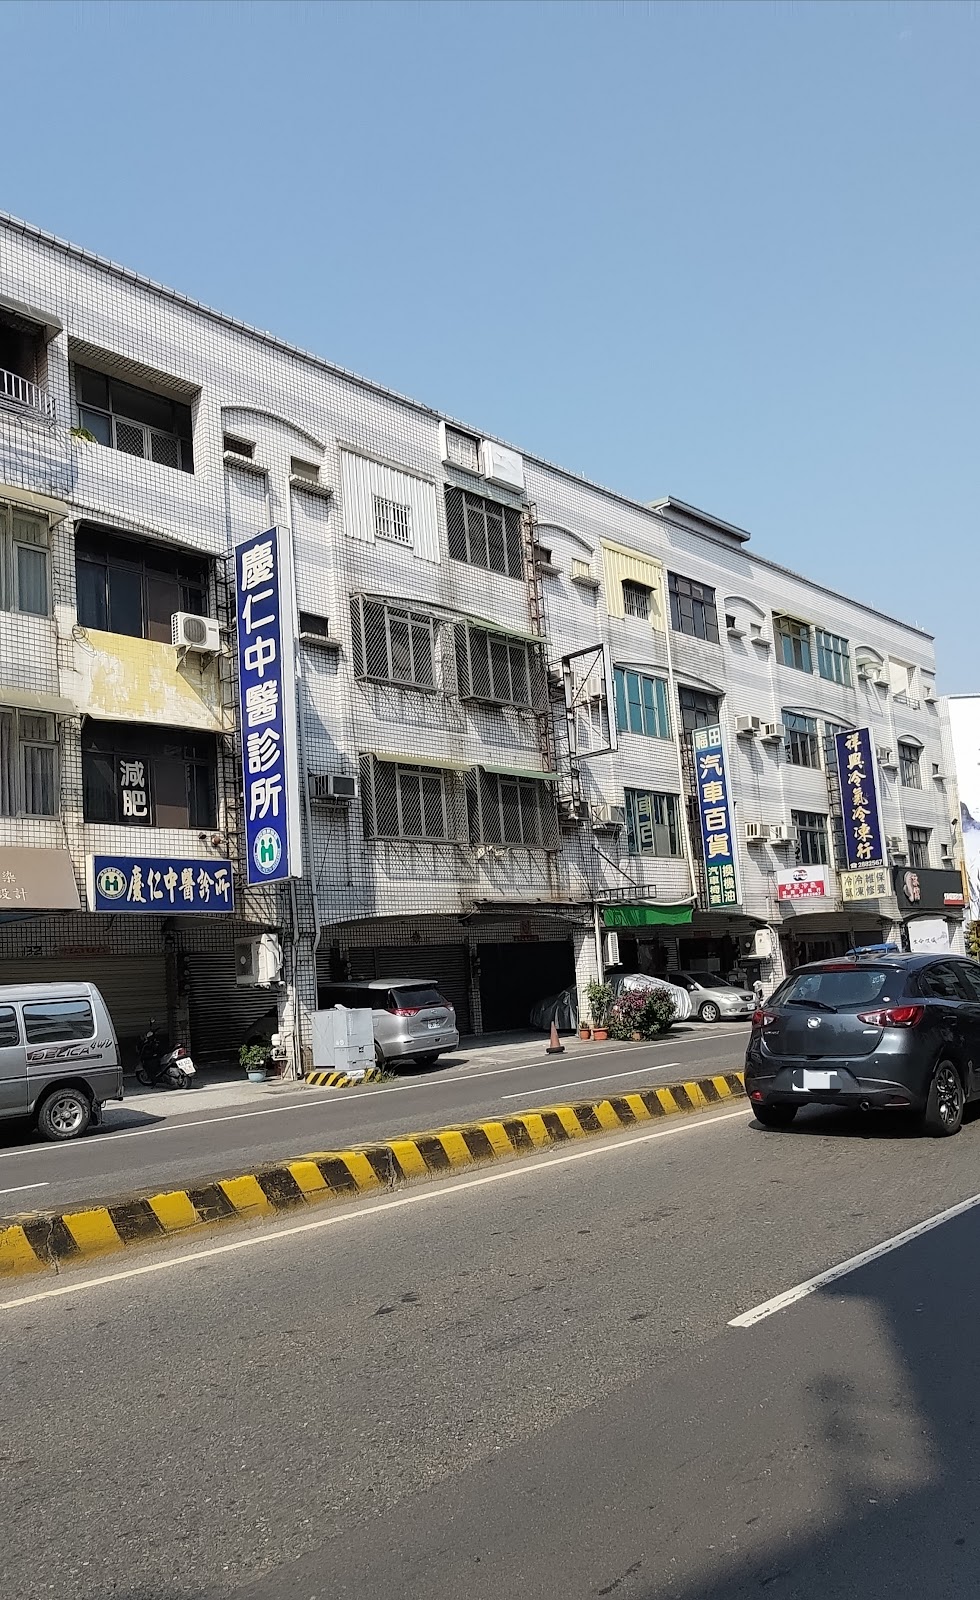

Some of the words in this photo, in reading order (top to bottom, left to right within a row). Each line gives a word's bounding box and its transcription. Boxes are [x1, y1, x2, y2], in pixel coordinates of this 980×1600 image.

[241, 540, 282, 821] 慶仁中醫診所
[695, 728, 721, 750] 福田
[120, 760, 148, 816] 減肥
[699, 754, 731, 859] 汽車百貨
[127, 865, 230, 903] 慶仁中醫診所
[32, 1047, 90, 1061] DELICA
[90, 1039, 113, 1050] 4WD
